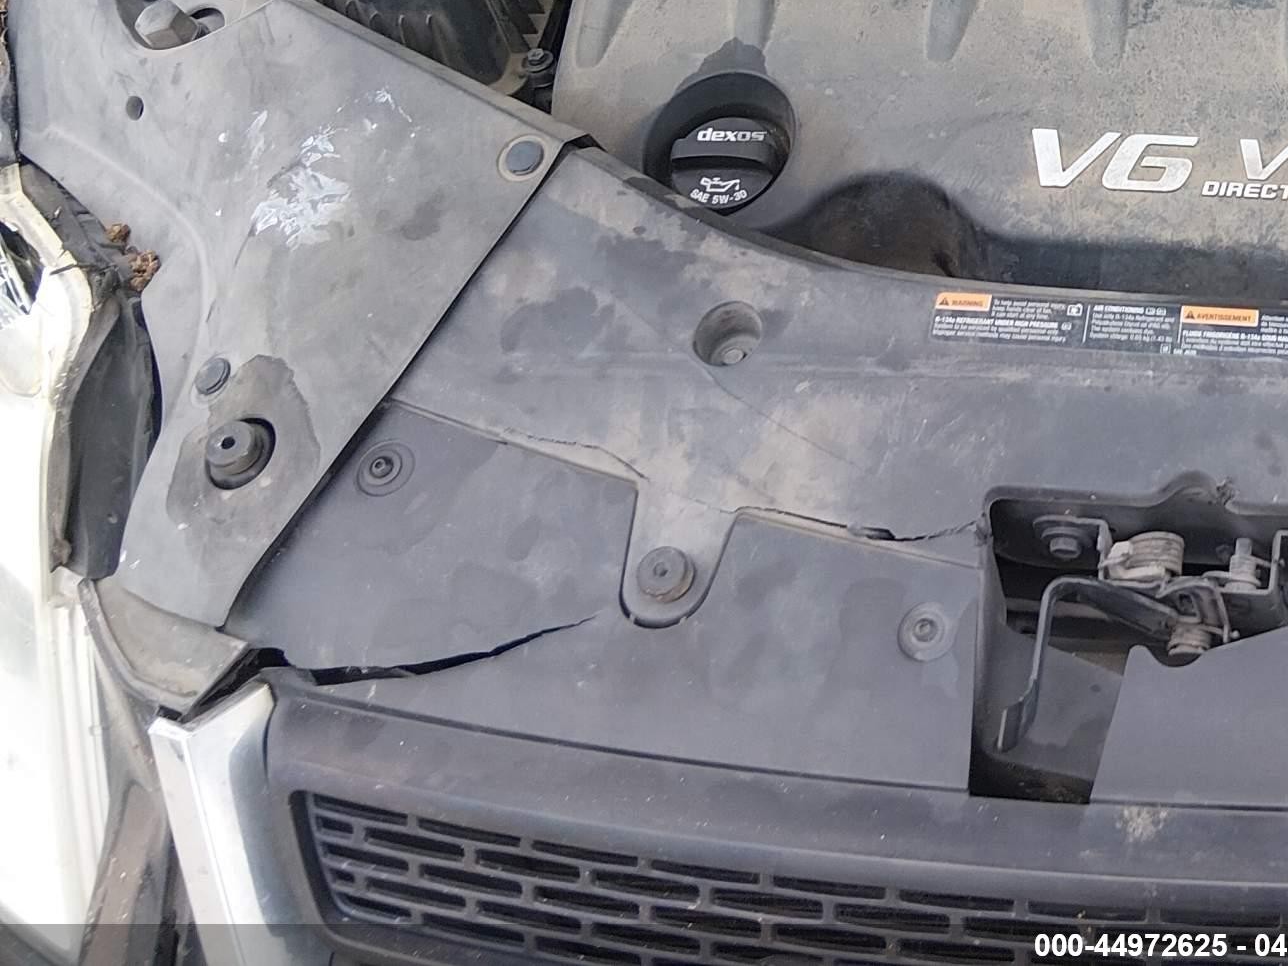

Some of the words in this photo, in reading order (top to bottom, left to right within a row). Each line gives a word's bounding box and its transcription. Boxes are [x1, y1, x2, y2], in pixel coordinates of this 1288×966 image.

[697, 128, 767, 141] dexos
[1032, 128, 1199, 193] V6
[690, 189, 710, 203] SAE
[712, 189, 748, 204] 5W-30
[951, 299, 984, 307] WARNING
[1093, 304, 1104, 312] AIR
[1104, 305, 1144, 314] CONDITIONING
[1196, 313, 1252, 324] AVERTISSEMENT
